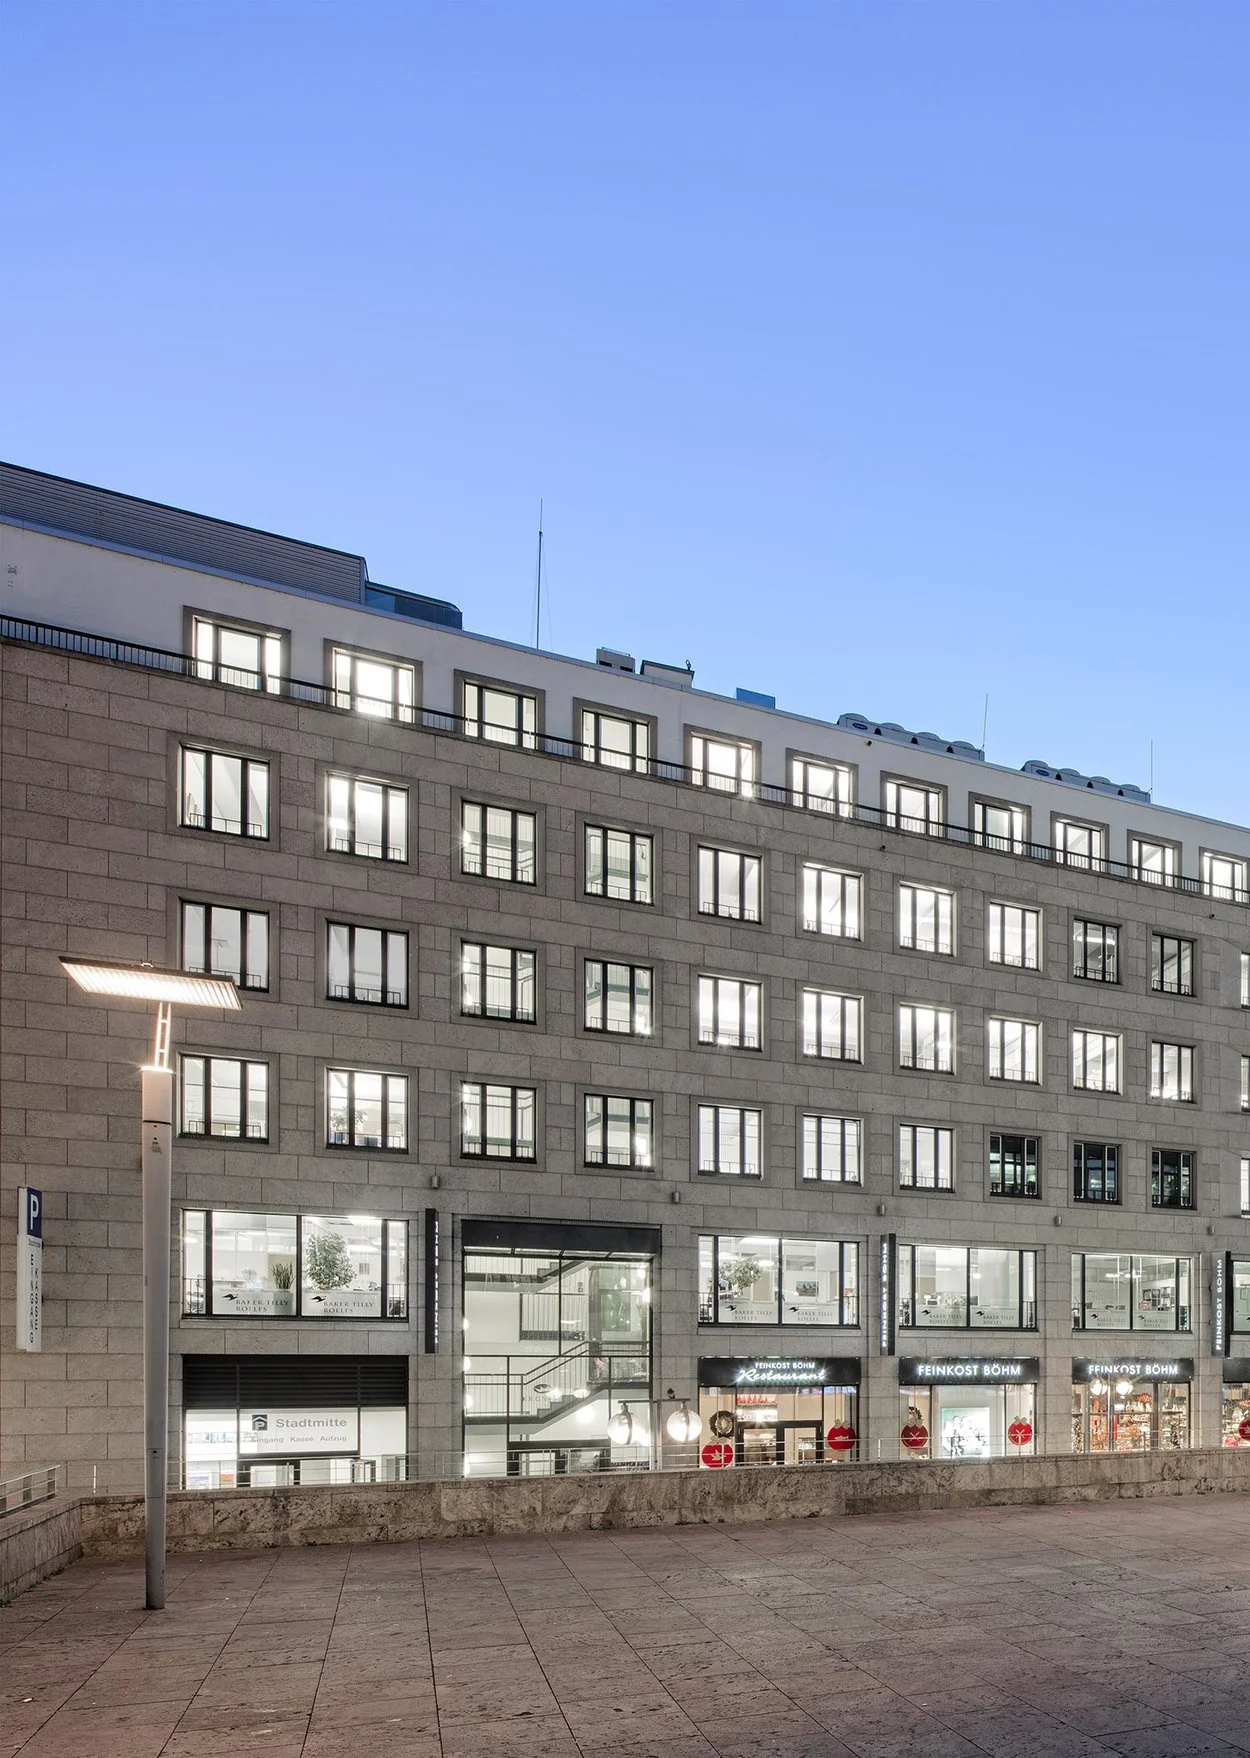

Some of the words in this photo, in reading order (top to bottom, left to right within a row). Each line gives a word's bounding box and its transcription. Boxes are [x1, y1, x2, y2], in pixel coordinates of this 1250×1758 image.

[30, 1194, 39, 1230] P
[793, 1361, 815, 1369] BÖHM
[918, 1365, 978, 1375] FEINKOST
[983, 1363, 1020, 1375] BÖHM
[1088, 1365, 1141, 1374] FEINKOST
[1145, 1363, 1178, 1375] BÖHM
[737, 1368, 825, 1381] Restaurant
[276, 1418, 347, 1428] Stadtmitte
